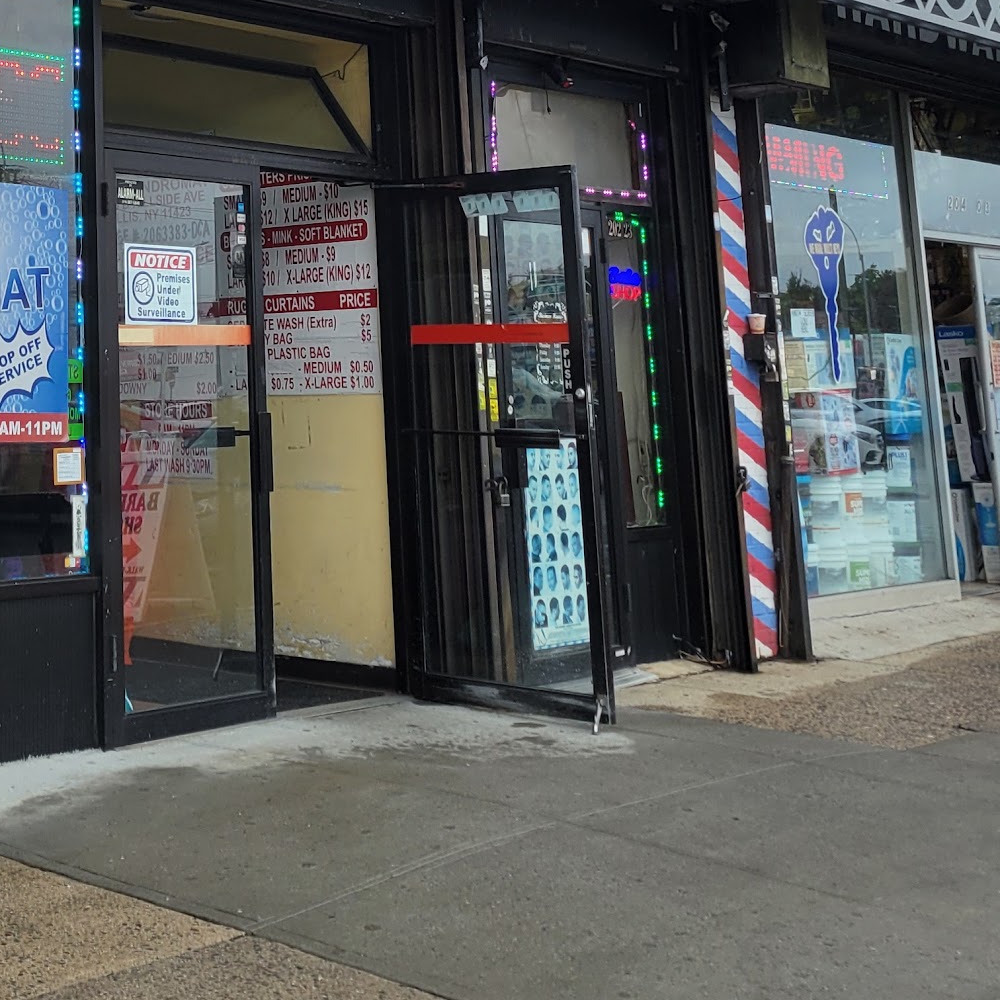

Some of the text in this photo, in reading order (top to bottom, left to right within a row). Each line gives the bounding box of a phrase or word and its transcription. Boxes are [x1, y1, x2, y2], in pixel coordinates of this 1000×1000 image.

[183, 190, 206, 204] AVE
[282, 185, 317, 204] MEDIUM
[324, 183, 339, 201] $10
[292, 204, 322, 223] LARGE
[324, 201, 352, 222] (KING)
[354, 199, 369, 217] $15
[272, 222, 364, 245] MINK SOFT BLANKET
[607, 219, 622, 237] 202
[134, 253, 188, 270] NOTICE
[285, 247, 319, 265] MEDIUM
[326, 245, 336, 263] $9
[156, 272, 191, 284] Premises
[286, 266, 324, 285] X-LARGE
[326, 264, 354, 286] (KING)
[356, 263, 371, 282] $12
[156, 284, 181, 294] Under
[157, 296, 179, 306] Video
[265, 292, 371, 312] CURTAINS PRICE
[137, 306, 186, 318] Surveillance
[277, 317, 304, 330] WASH
[306, 315, 337, 332] (Extra)
[360, 313, 371, 327] $2
[273, 329, 372, 345] BAG $5
[17, 337, 43, 358] OFF
[267, 345, 331, 360] PLASTIC BAG
[194, 351, 215, 366] $2.50
[303, 360, 374, 375] MEDIUM $0.50
[561, 348, 573, 390] PUSH
[196, 381, 217, 395] $2.00
[271, 375, 375, 390] $0.75 X-LARGE $1.00
